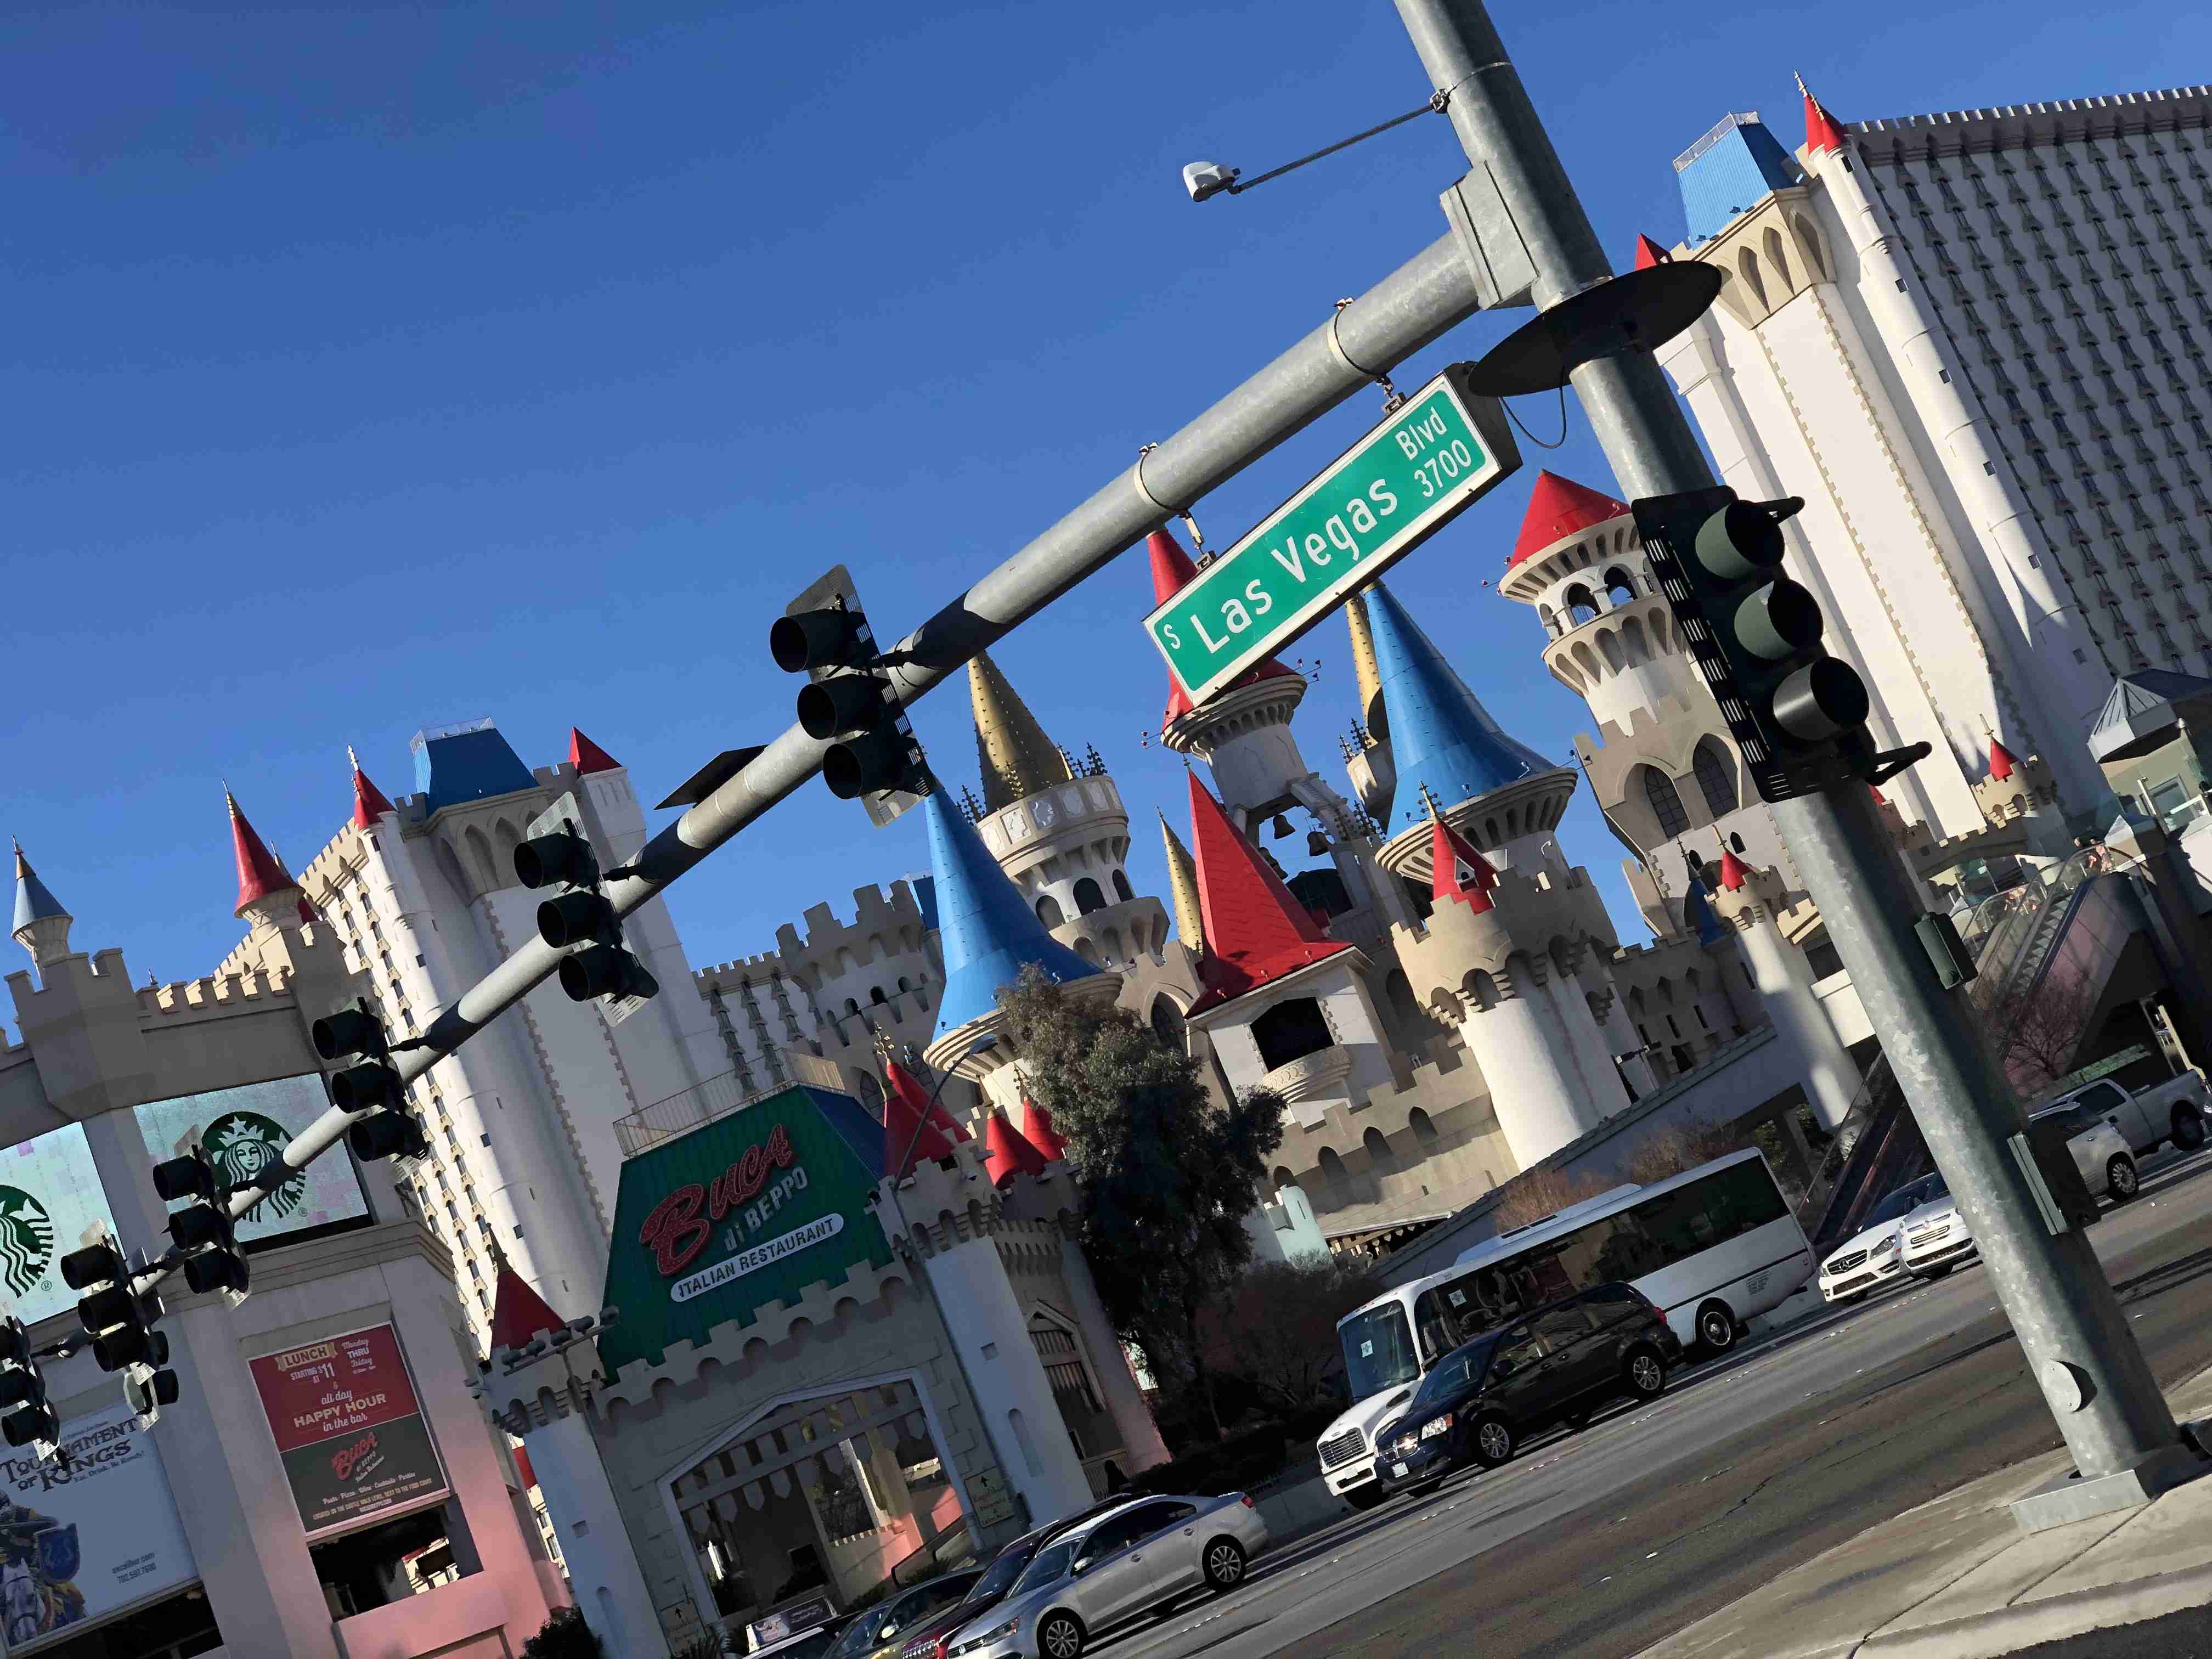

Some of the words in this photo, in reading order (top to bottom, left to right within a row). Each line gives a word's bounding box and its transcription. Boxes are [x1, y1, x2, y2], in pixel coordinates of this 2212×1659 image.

[1414, 439, 1472, 498] 3700
[1164, 624, 1181, 650] S
[1190, 579, 1272, 654] Las
[1271, 478, 1397, 583] Vegas
[1395, 407, 1448, 461] Blvd
[724, 1222, 744, 1251] di
[744, 1166, 808, 1233] BEPPO
[678, 1262, 735, 1297] ITALIAN
[739, 1218, 834, 1271] RESTAURANT
[285, 1346, 328, 1367] LUNCH
[347, 1347, 369, 1358] THRU
[290, 1367, 318, 1380] STARTING
[294, 1406, 340, 1427] HAPPY
[345, 1393, 386, 1413] HOUR
[321, 1393, 334, 1404] all
[335, 1390, 352, 1401] day
[323, 1422, 334, 1432] in
[334, 1418, 349, 1428] the
[351, 1413, 368, 1424] bar
[37, 1439, 132, 1492] KINGS
